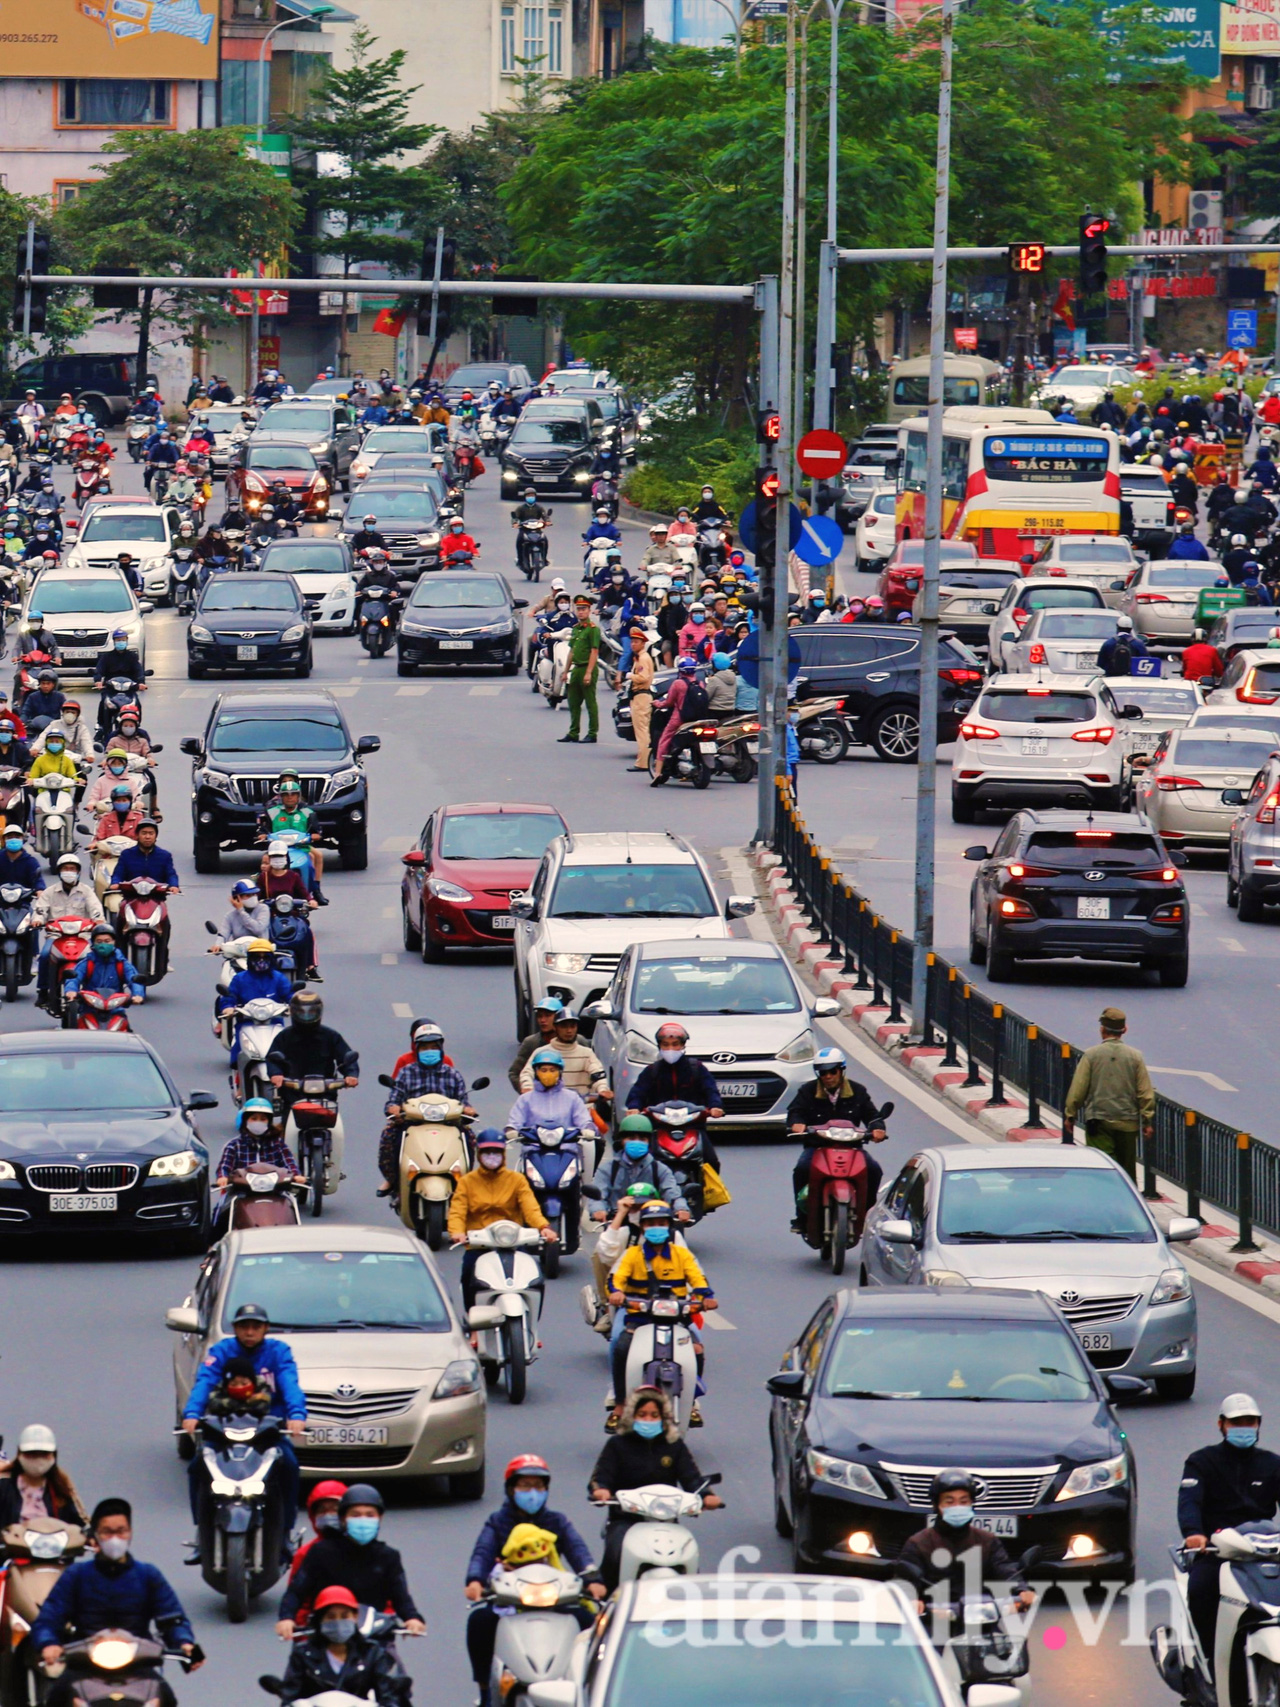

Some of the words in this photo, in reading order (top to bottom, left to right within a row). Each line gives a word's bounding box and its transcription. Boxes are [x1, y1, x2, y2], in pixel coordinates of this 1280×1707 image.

[1019, 245, 1043, 271] 12
[1053, 458, 1078, 470] HÀ
[494, 917, 518, 928] 51F-1
[719, 1084, 756, 1096] 442.72
[52, 1197, 115, 1210] 30E-375.03
[308, 1428, 384, 1443] 30E-964.21
